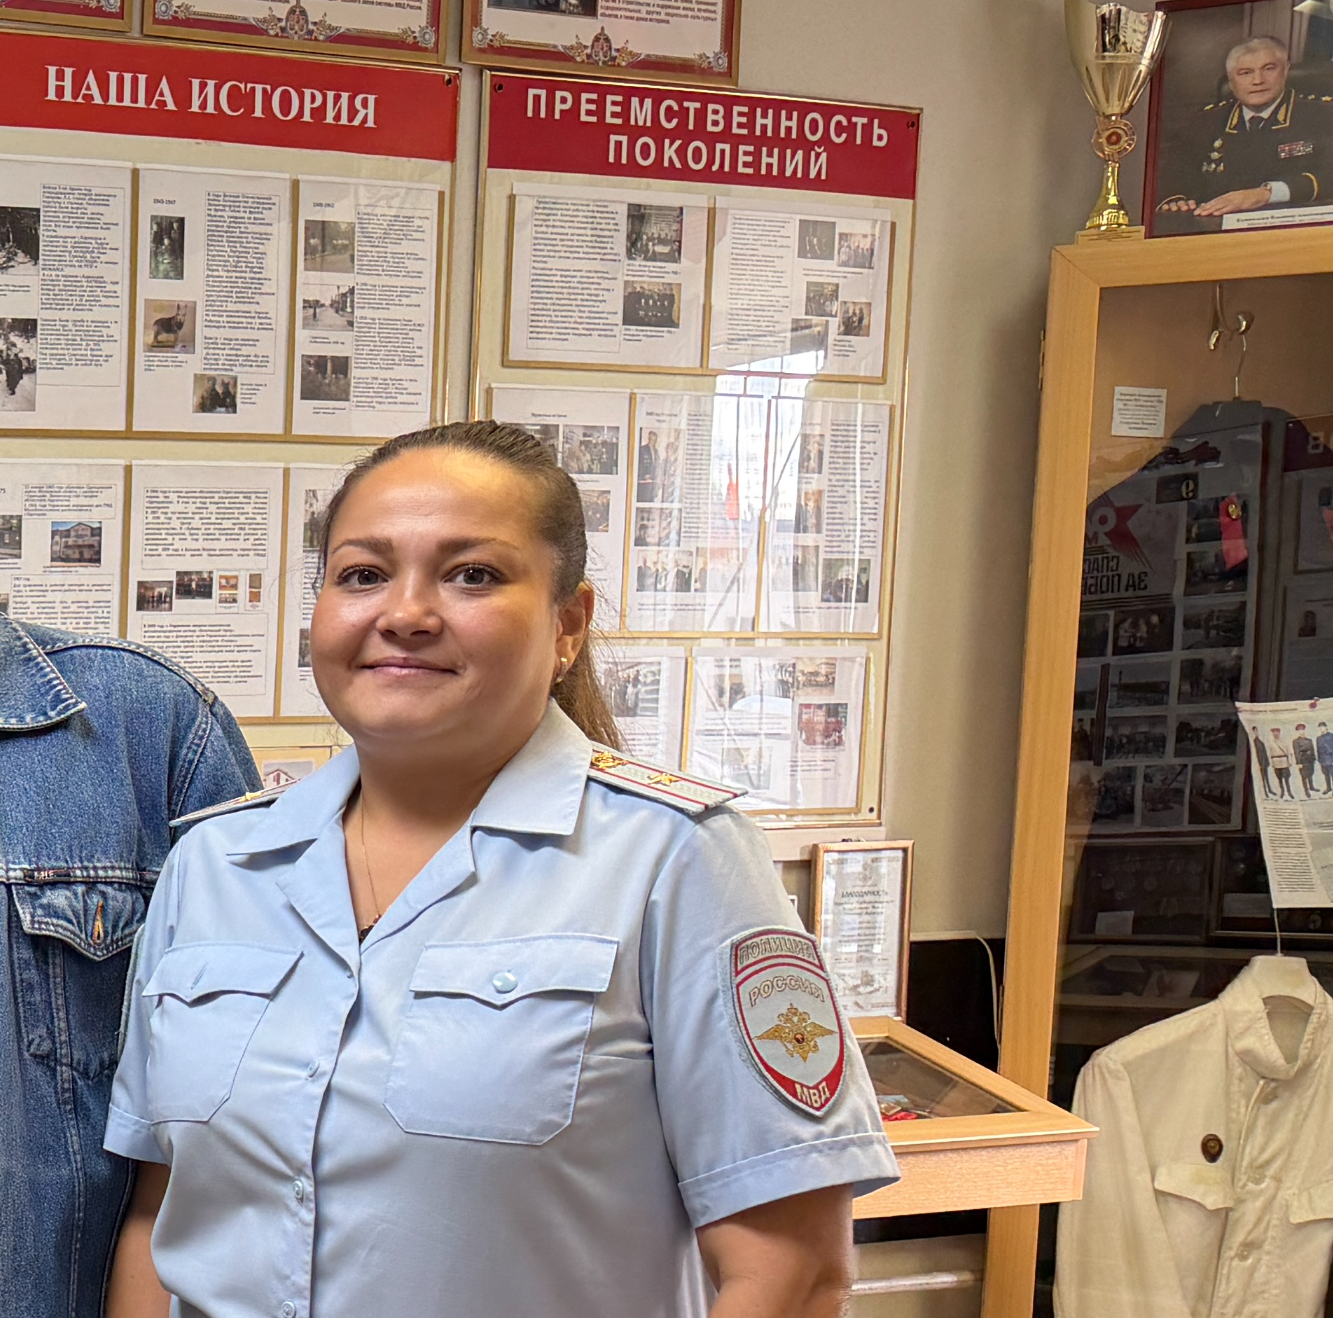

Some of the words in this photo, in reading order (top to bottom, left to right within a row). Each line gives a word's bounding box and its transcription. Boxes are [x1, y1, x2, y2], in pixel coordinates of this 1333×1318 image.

[44, 65, 178, 111] НАША
[187, 78, 379, 128] ИСТОРИЯ
[526, 88, 889, 147] ПРЕЕМСТВЕННОСТЬ
[608, 134, 828, 180] ПОКОЛЕНИЙ
[738, 936, 816, 966] ПОЛИЦИЯ
[749, 975, 825, 1007] РОССИЯ
[795, 1081, 830, 1108] МВД
